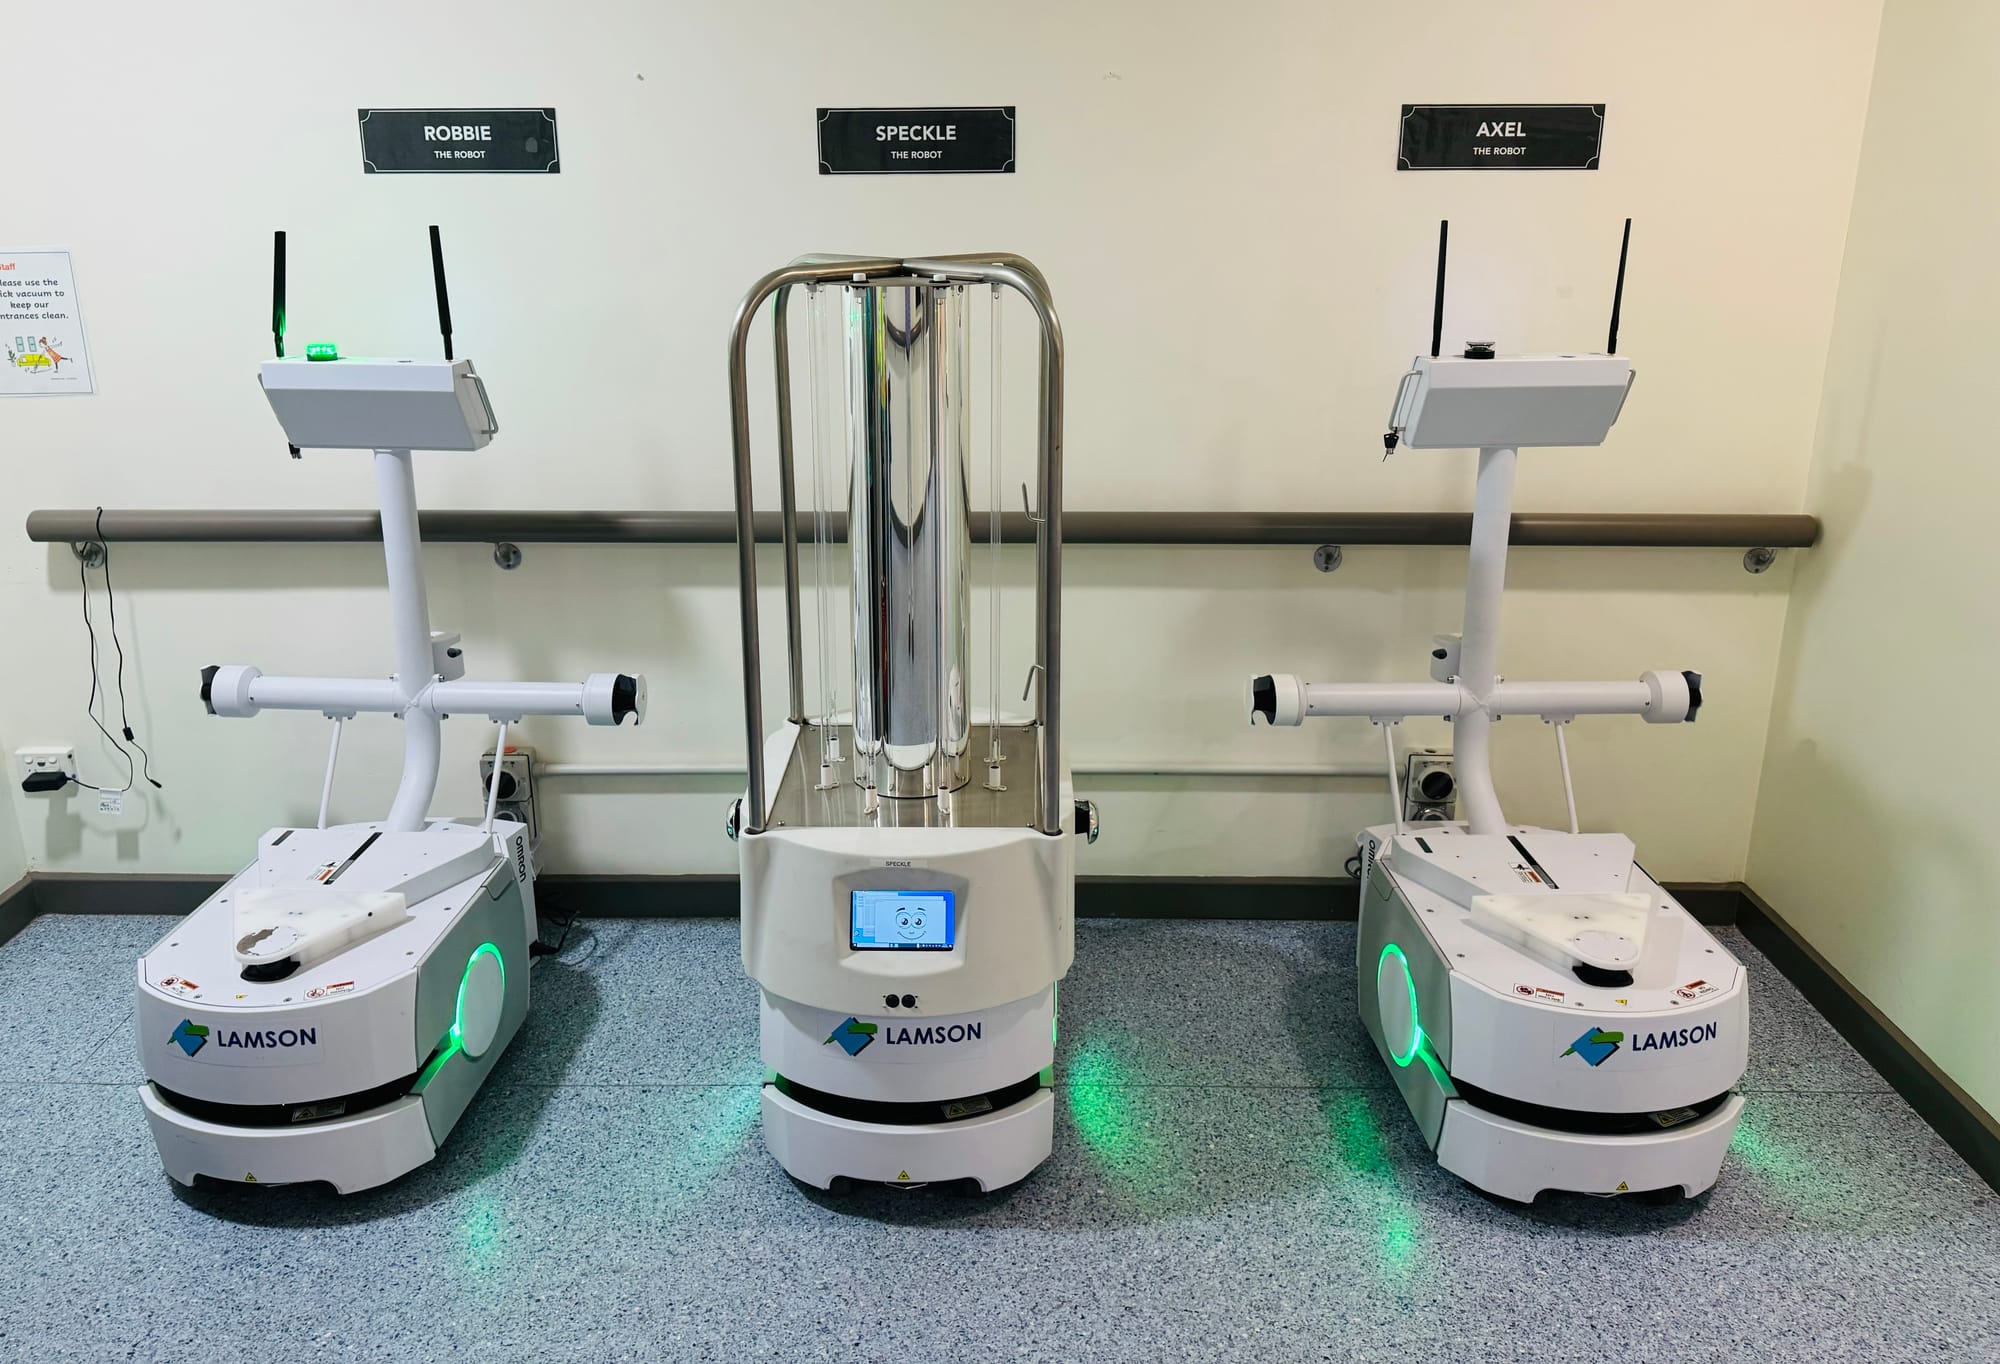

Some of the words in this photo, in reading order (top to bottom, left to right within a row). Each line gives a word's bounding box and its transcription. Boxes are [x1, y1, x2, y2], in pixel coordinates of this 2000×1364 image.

[424, 125, 492, 141] ROBBIE
[875, 125, 957, 141] SPECKLE
[1475, 121, 1527, 137] AXEL
[433, 150, 452, 159] THE
[454, 150, 486, 159] ROBOT
[890, 150, 909, 159] THE
[911, 150, 943, 159] ROBOT
[1472, 147, 1491, 155] THE
[1493, 147, 1527, 155] ROBOT
[0, 262, 16, 271] taff
[43, 278, 59, 286] the
[0, 289, 13, 297] ick
[10, 301, 31, 311] keep
[41, 311, 69, 320] clean.
[217, 1027, 317, 1049] LAMSON
[886, 1022, 982, 1045] LAMSON
[1632, 1021, 1717, 1052] LAMSON
